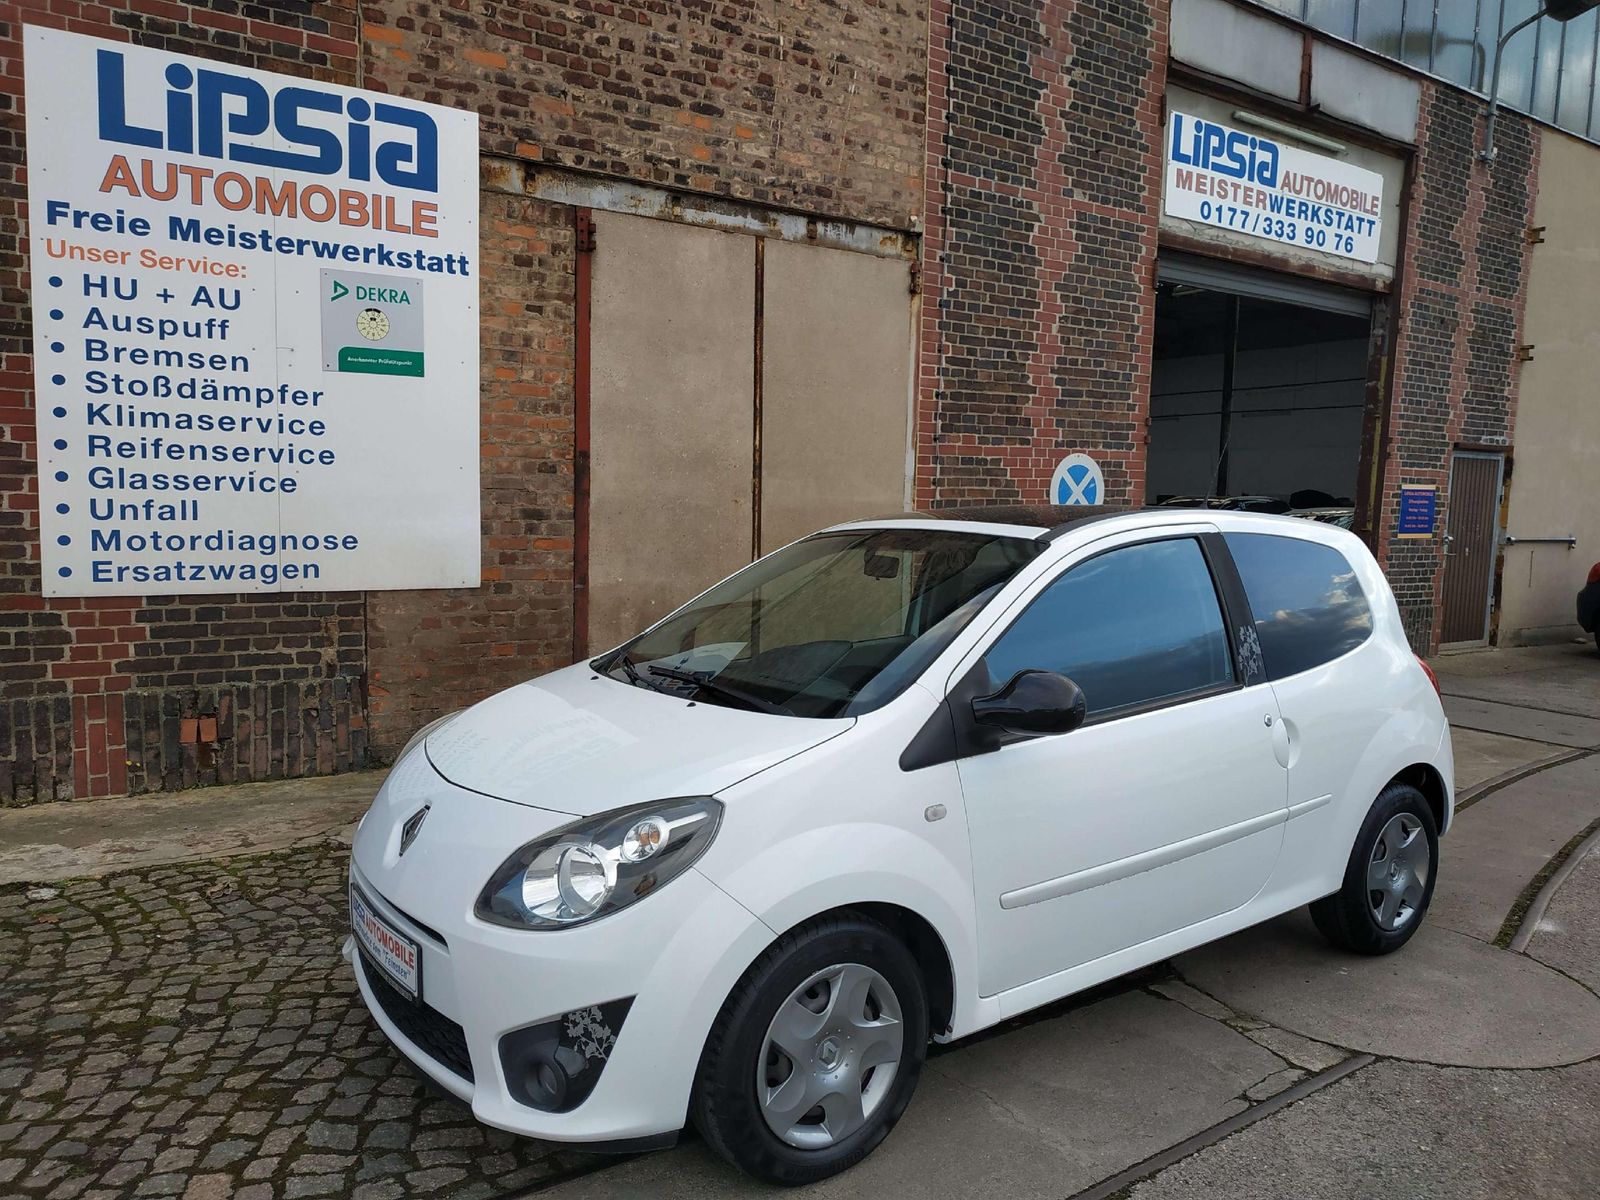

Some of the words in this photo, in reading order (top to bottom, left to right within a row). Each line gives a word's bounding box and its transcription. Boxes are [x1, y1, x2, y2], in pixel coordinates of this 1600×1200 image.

[99, 154, 439, 238] AUTOMOBILE
[1175, 168, 1375, 237] MEISTERWERKSTATT
[1280, 170, 1379, 216] AUTOMOBILE
[46, 200, 151, 236] Freie
[168, 216, 470, 276] Meisterwerkstatt
[1200, 200, 1296, 241] 0177/333
[1304, 227, 1326, 247] 90
[1334, 233, 1354, 253] 76
[46, 238, 131, 264] Unser
[139, 249, 248, 279] Service:
[83, 273, 138, 301] HU
[156, 288, 175, 304] +
[191, 285, 241, 311] AU
[356, 285, 411, 305] DEKRA
[82, 307, 230, 341] Auspuff
[85, 338, 249, 373] Bremsen
[85, 370, 324, 409] Stoßdämpfer
[87, 403, 326, 436] Klimaservice
[87, 434, 336, 466] Reifenservice
[88, 466, 298, 494] Glasservice
[90, 498, 199, 521] Unfall
[91, 529, 359, 556] Motordiagnose
[92, 560, 321, 585] Ersatzwagen
[364, 912, 415, 970] AUTOMOBILE
